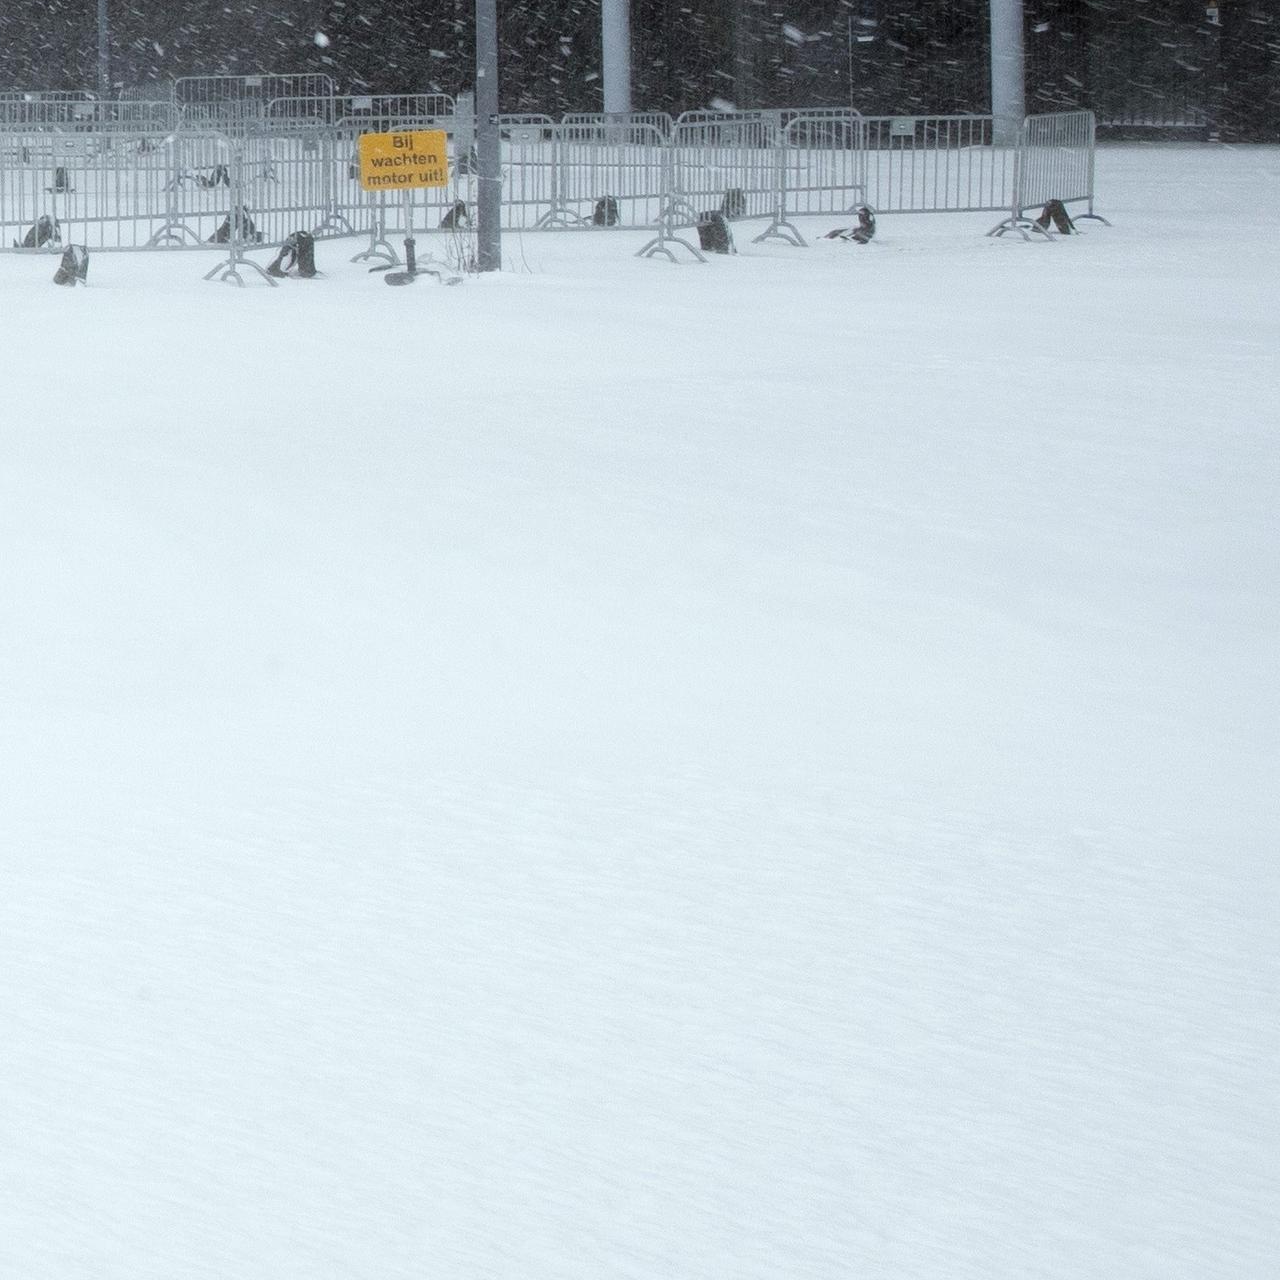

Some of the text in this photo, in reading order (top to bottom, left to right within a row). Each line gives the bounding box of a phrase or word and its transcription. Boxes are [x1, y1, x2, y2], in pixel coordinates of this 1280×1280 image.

[392, 135, 414, 151] Bij
[371, 153, 438, 168] wachten
[367, 168, 445, 186] motor uit!
